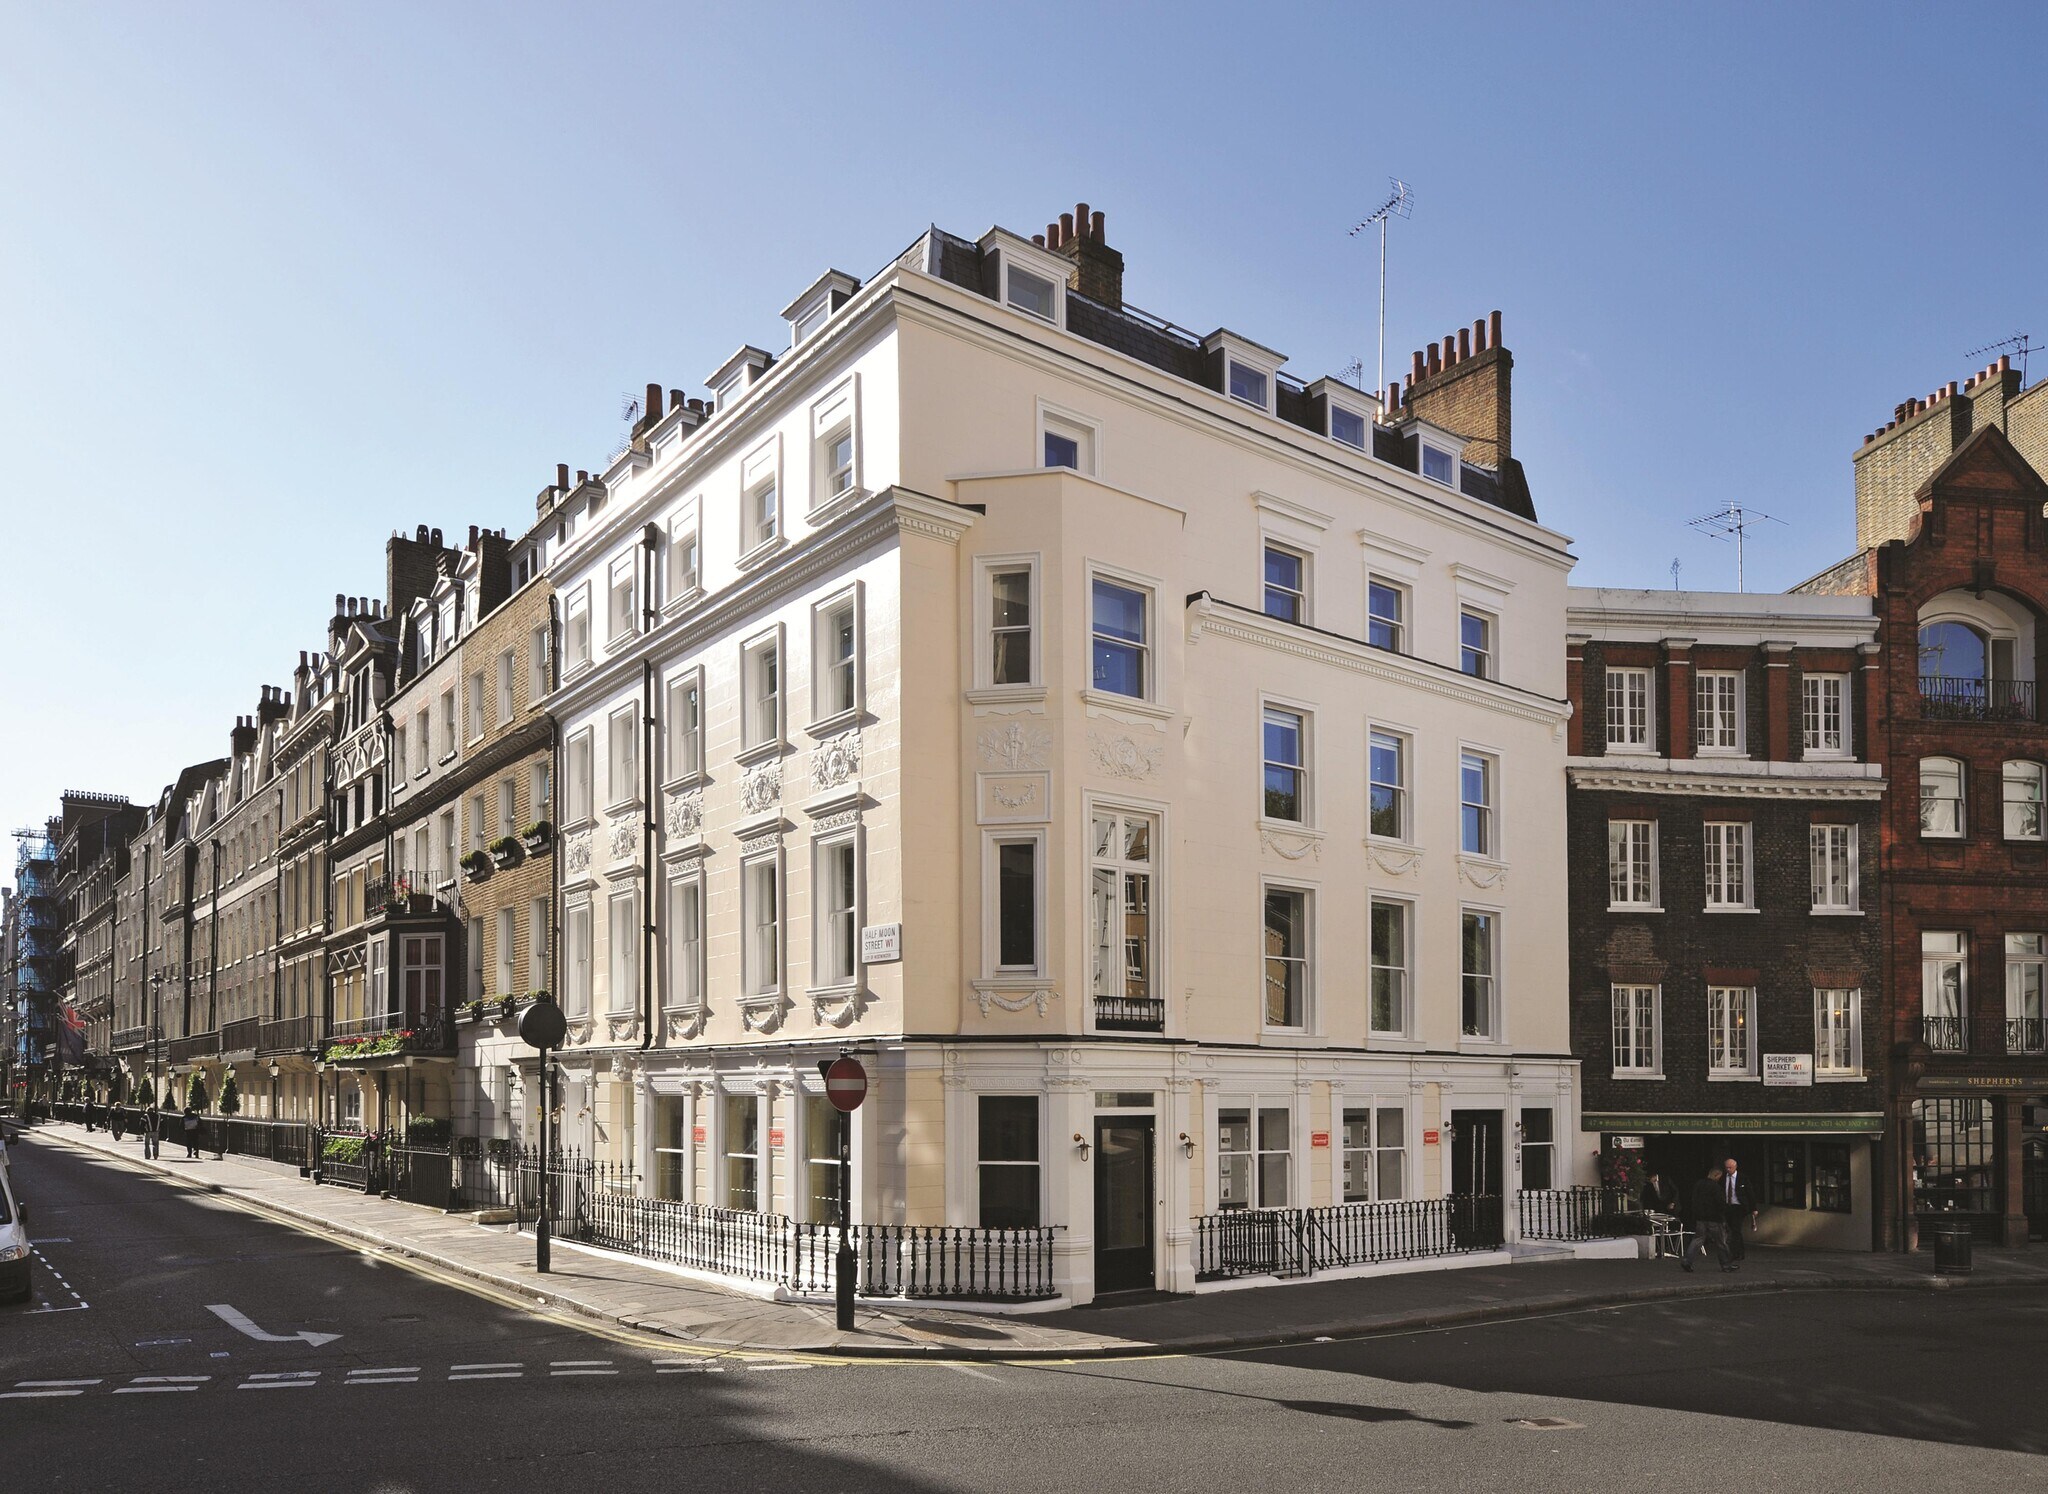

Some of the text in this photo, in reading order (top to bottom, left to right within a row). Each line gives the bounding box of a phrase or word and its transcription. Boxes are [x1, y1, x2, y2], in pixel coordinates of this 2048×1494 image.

[865, 927, 896, 940] HALF MOON
[865, 939, 883, 951] STREET
[1967, 1077, 2024, 1085] SHEPHERDS
[1711, 1118, 1724, 1128] Da
